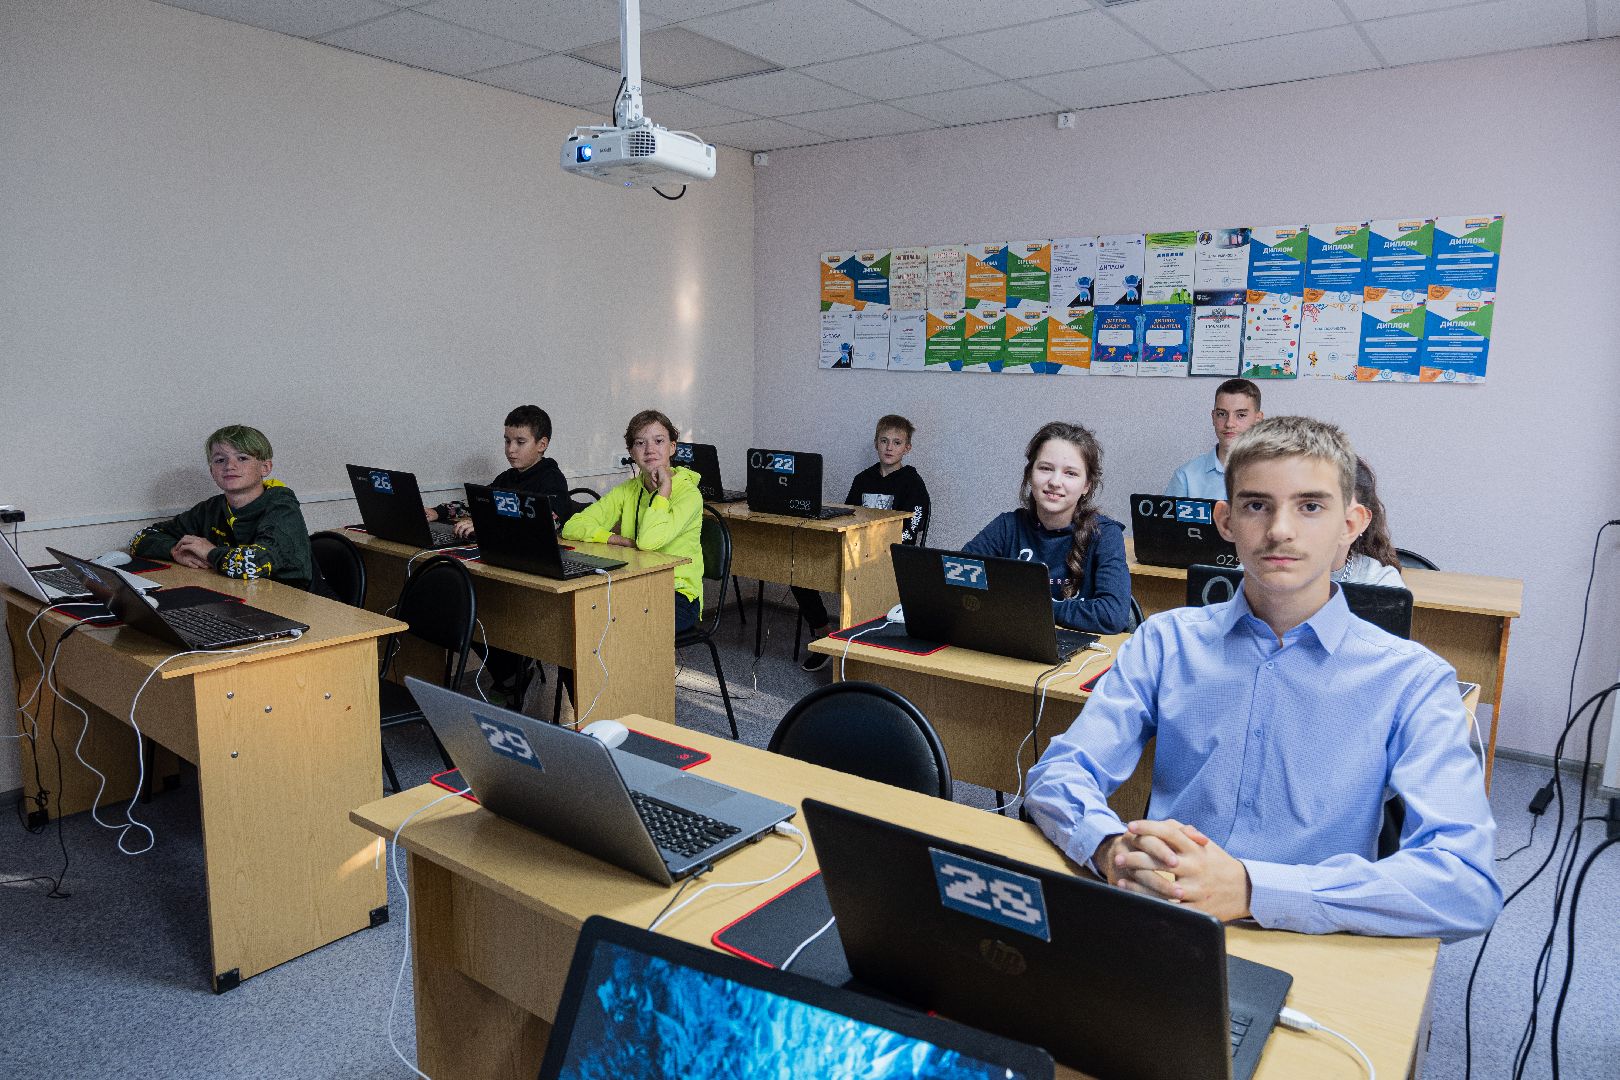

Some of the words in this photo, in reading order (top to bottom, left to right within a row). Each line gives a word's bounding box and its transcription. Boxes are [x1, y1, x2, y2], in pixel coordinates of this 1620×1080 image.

[1322, 243, 1354, 251] ДИПЛОМ
[1383, 240, 1418, 248] ДИПЛОМ
[1449, 237, 1485, 246] ДИПЛОМ
[1262, 246, 1293, 255] ДИПЛОМ
[1376, 322, 1410, 330] ДИПЛОМ
[1440, 320, 1476, 329] ДИПЛОМ
[677, 447, 692, 458] 23
[774, 457, 793, 470] 22
[372, 475, 392, 489] 26
[495, 496, 518, 512] 25
[1177, 504, 1209, 520] 21
[945, 561, 982, 583] 27
[480, 722, 534, 760] 29
[940, 864, 1042, 924] 28
